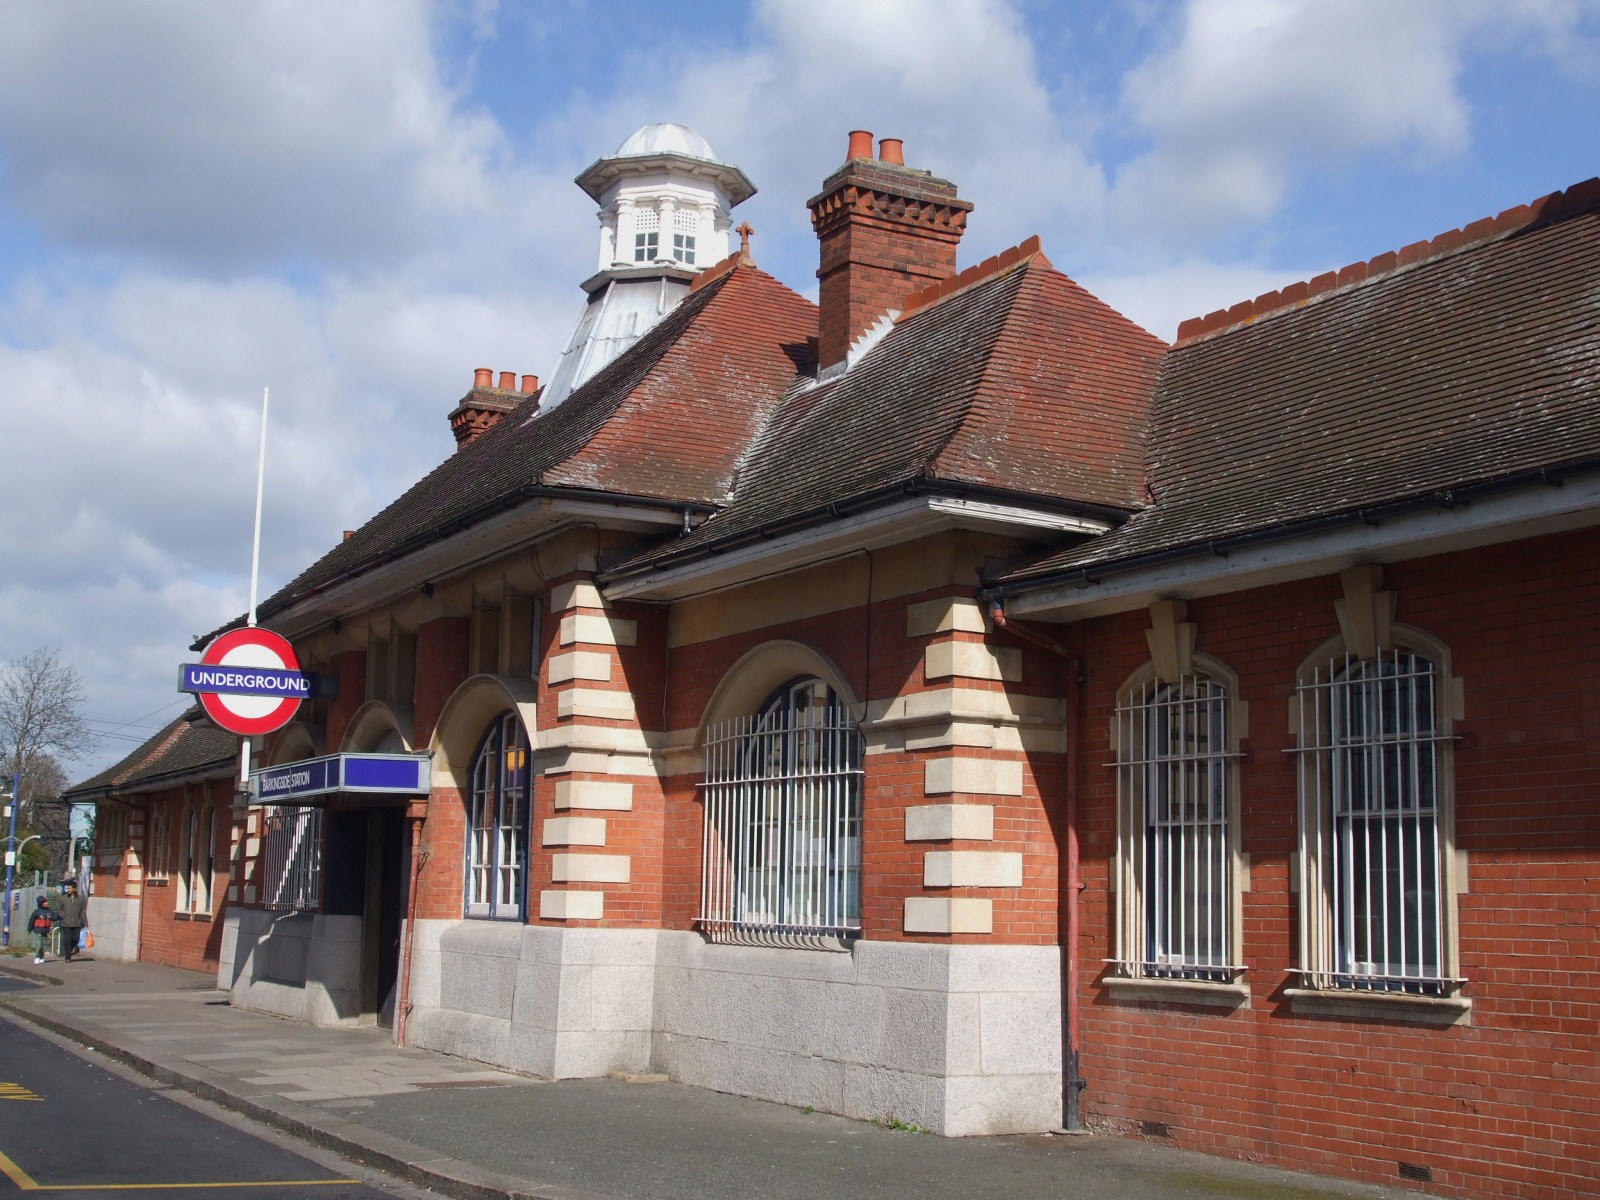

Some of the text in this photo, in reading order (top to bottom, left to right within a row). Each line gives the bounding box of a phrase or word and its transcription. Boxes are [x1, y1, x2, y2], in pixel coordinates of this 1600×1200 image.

[191, 671, 310, 691] UNDERGROUND
[262, 770, 310, 792] BARKINGSIDE STATION
